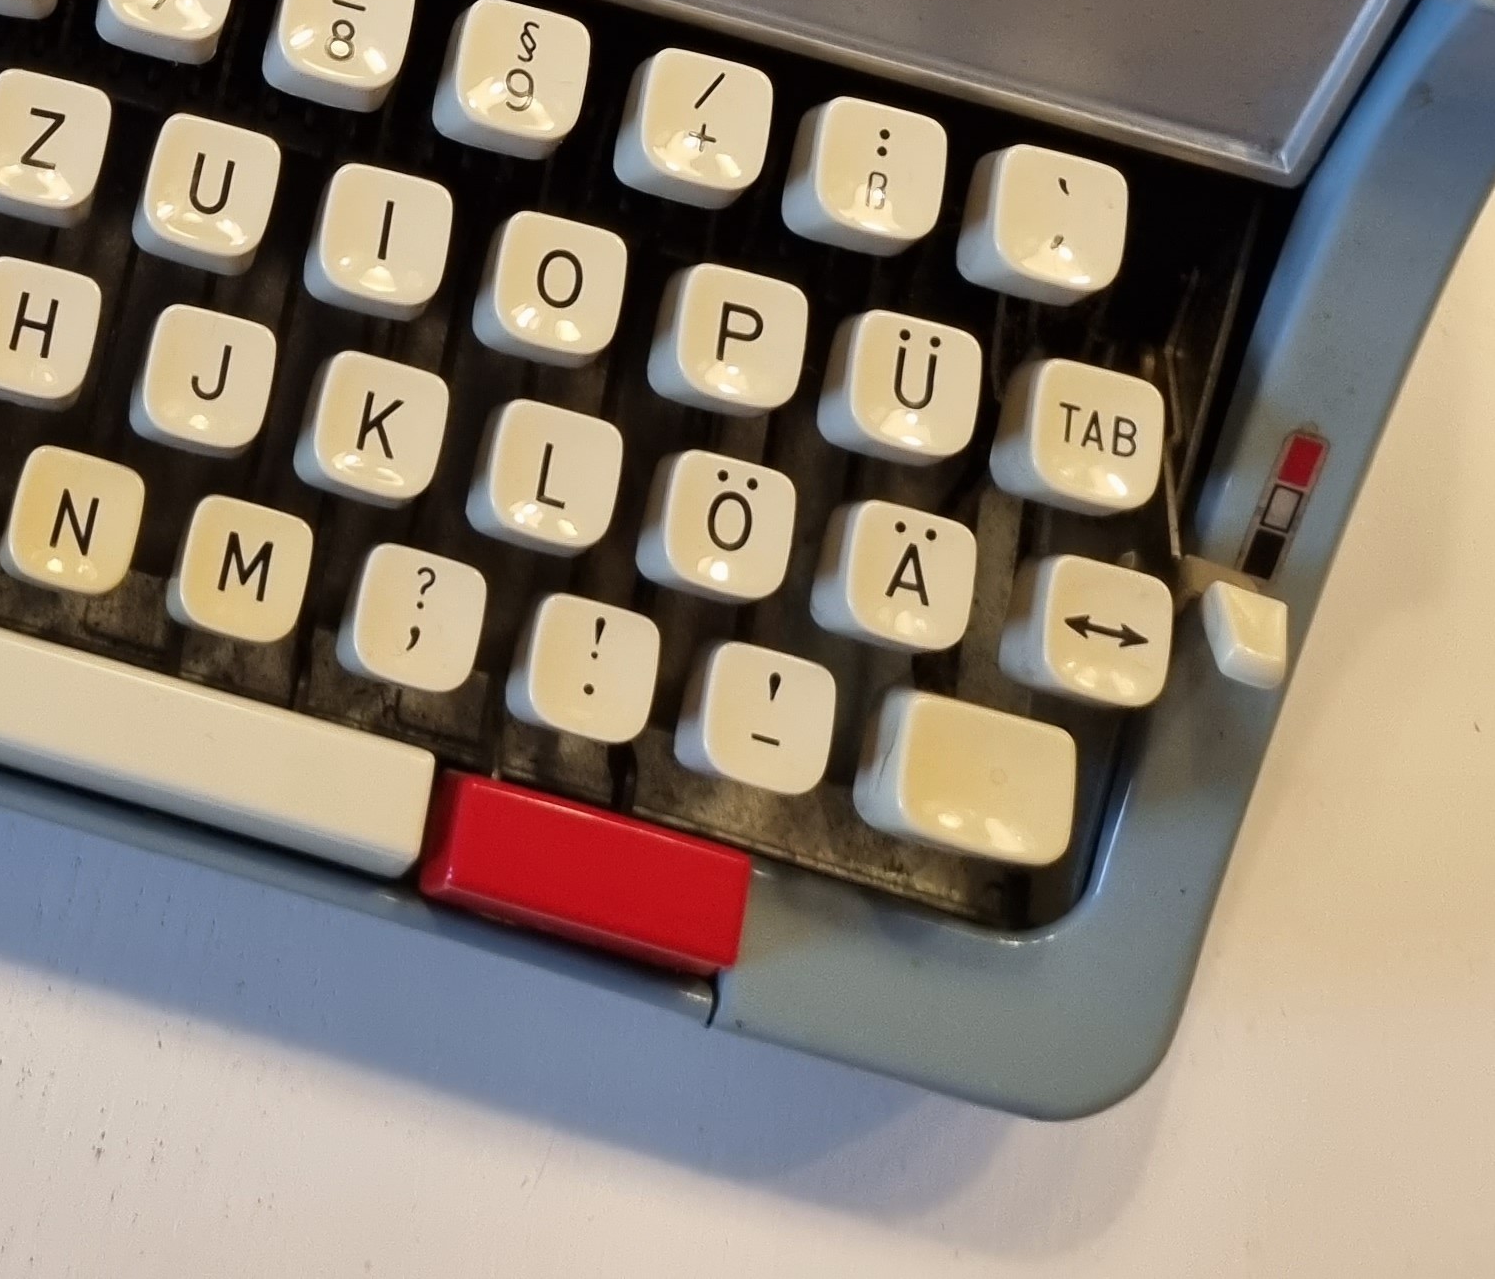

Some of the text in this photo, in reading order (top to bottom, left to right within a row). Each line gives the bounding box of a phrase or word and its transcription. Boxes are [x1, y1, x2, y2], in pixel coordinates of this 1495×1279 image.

[325, 19, 355, 61] 8
[518, 22, 539, 62] §
[505, 68, 535, 112] 9
[21, 108, 65, 170] Z
[877, 129, 890, 156] :
[190, 153, 235, 214] U
[378, 201, 394, 260] I
[537, 250, 583, 308] O
[9, 292, 58, 358] H
[717, 302, 763, 361] P
[192, 345, 232, 400] J
[893, 328, 942, 410] Ü
[357, 391, 404, 459] K
[1060, 403, 1136, 457] TAB
[536, 443, 565, 509] L
[50, 489, 99, 556] N
[707, 469, 759, 552] Ö
[218, 532, 273, 601] M
[417, 567, 435, 609] ?
[885, 521, 937, 607] Ä
[591, 618, 605, 659] !
